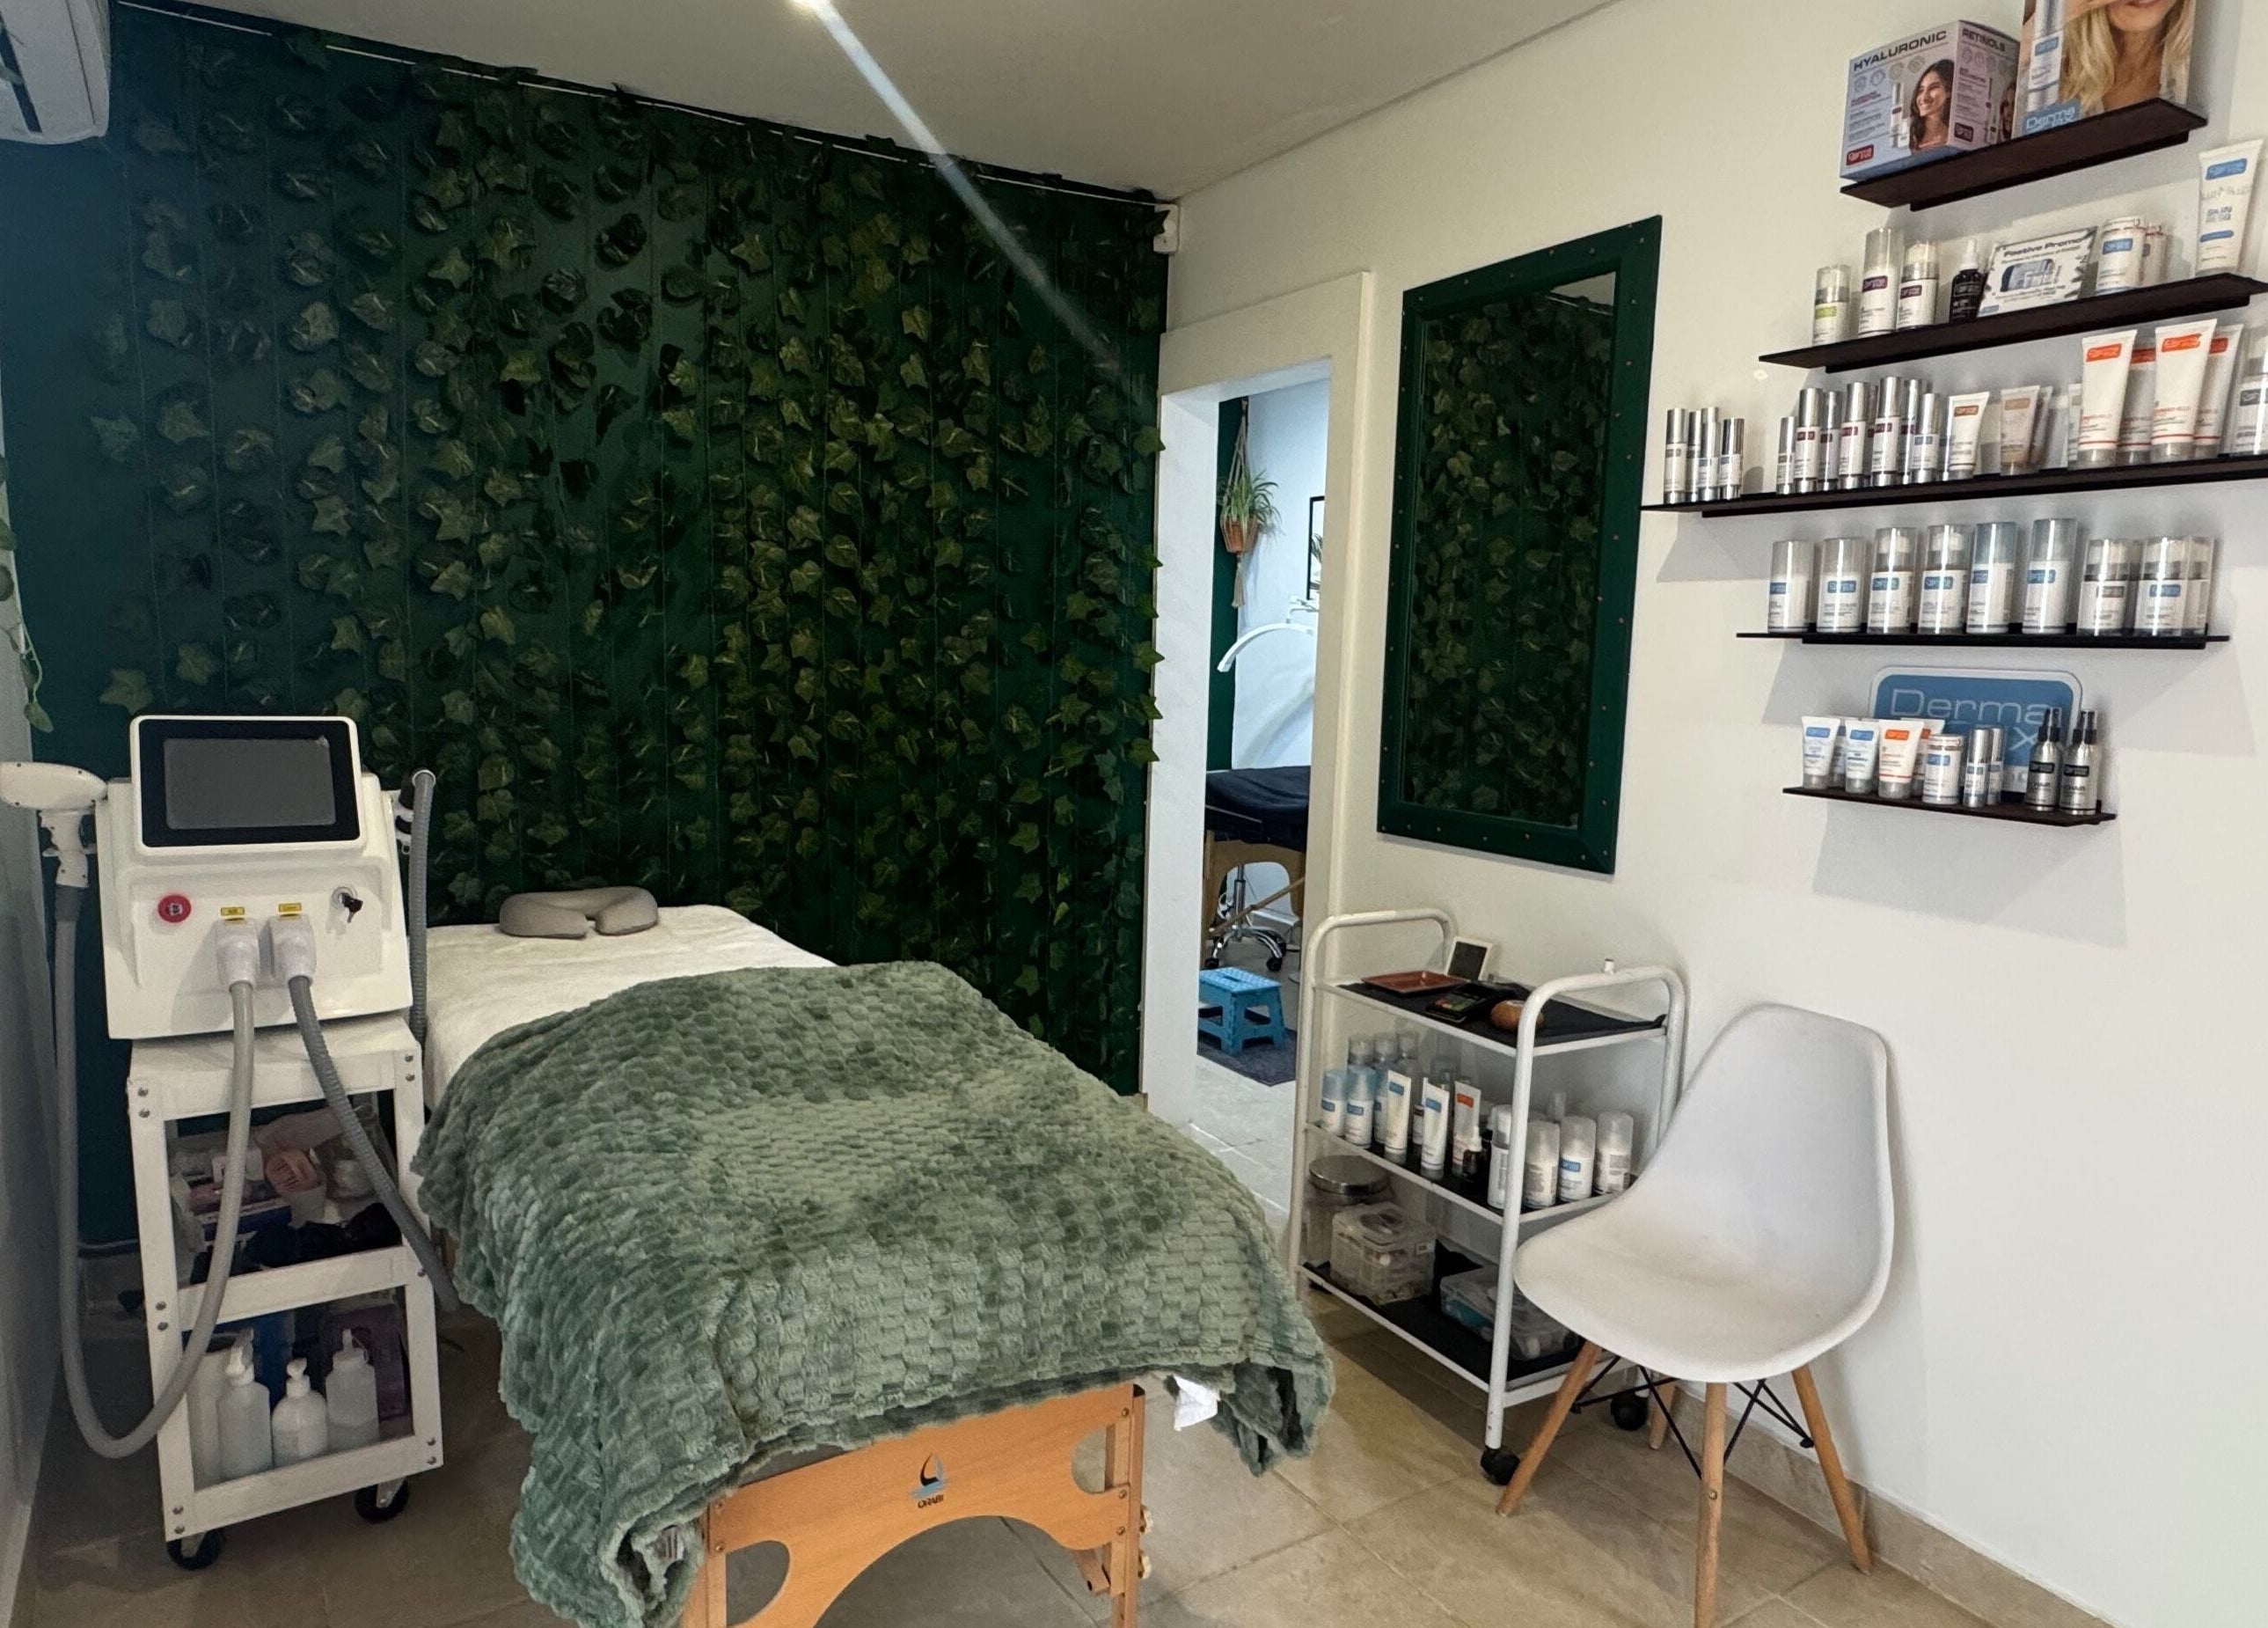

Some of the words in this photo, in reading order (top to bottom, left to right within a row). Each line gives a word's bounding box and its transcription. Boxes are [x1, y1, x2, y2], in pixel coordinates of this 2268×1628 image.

[1854, 30, 1947, 70] HYALURONIC
[1962, 28, 2006, 52] RETINOLS
[1891, 688, 2062, 726] Derma
